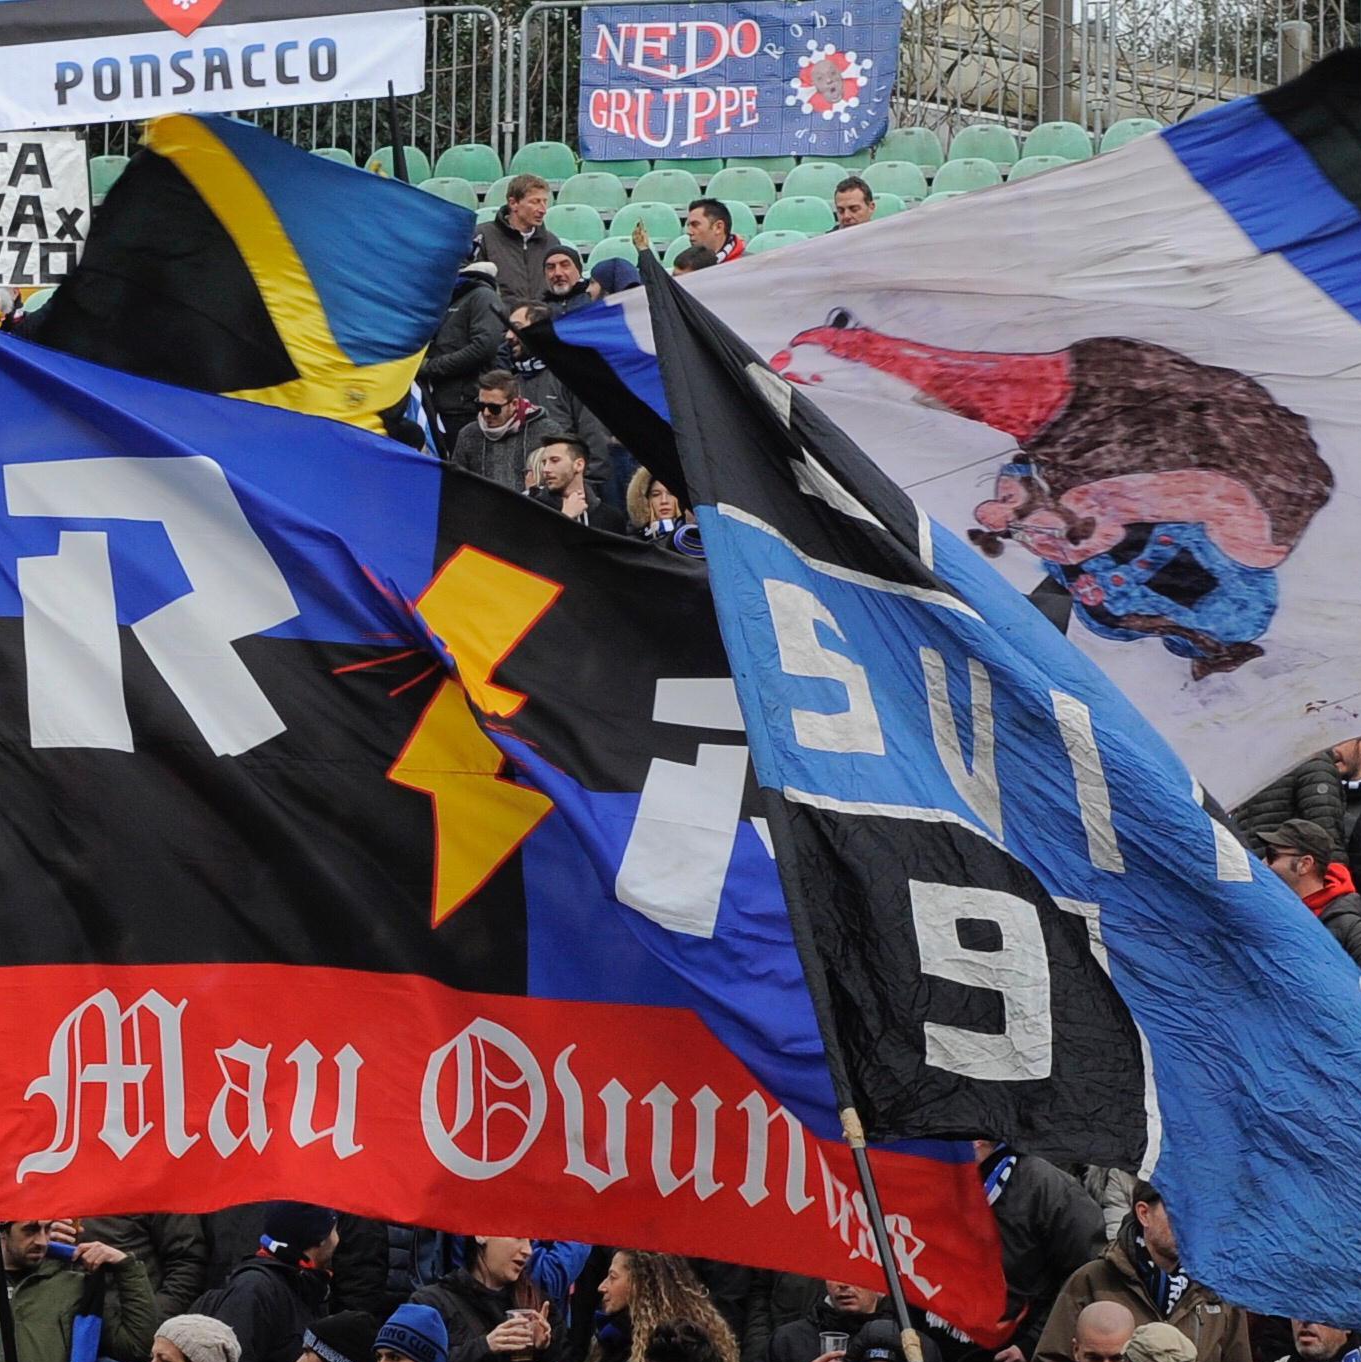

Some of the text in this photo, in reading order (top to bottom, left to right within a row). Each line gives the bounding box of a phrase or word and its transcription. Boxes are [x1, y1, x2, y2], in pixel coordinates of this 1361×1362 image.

[592, 19, 761, 80] NEDO
[764, 11, 853, 60] Roba
[54, 37, 338, 105] PONSACCO
[589, 86, 760, 148] GRUPPE
[2, 455, 300, 757] R
[908, 880, 1053, 1082] 9
[15, 987, 364, 1183] Mau
